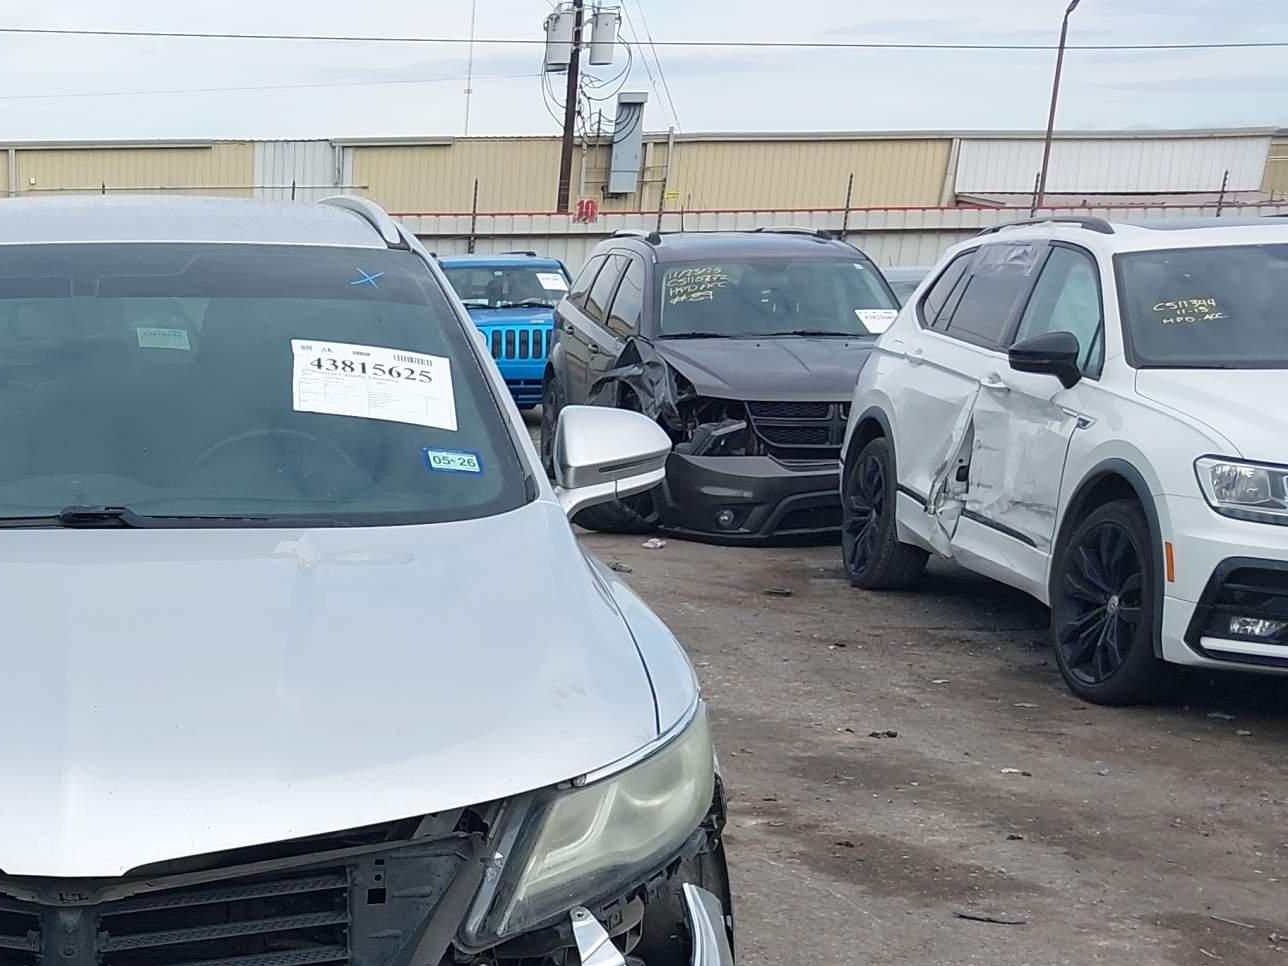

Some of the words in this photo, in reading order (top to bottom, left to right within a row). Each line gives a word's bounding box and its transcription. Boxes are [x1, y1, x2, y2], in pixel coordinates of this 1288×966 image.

[310, 357, 433, 383] 43815625
[432, 455, 451, 465] 05
[457, 457, 477, 467] 26
